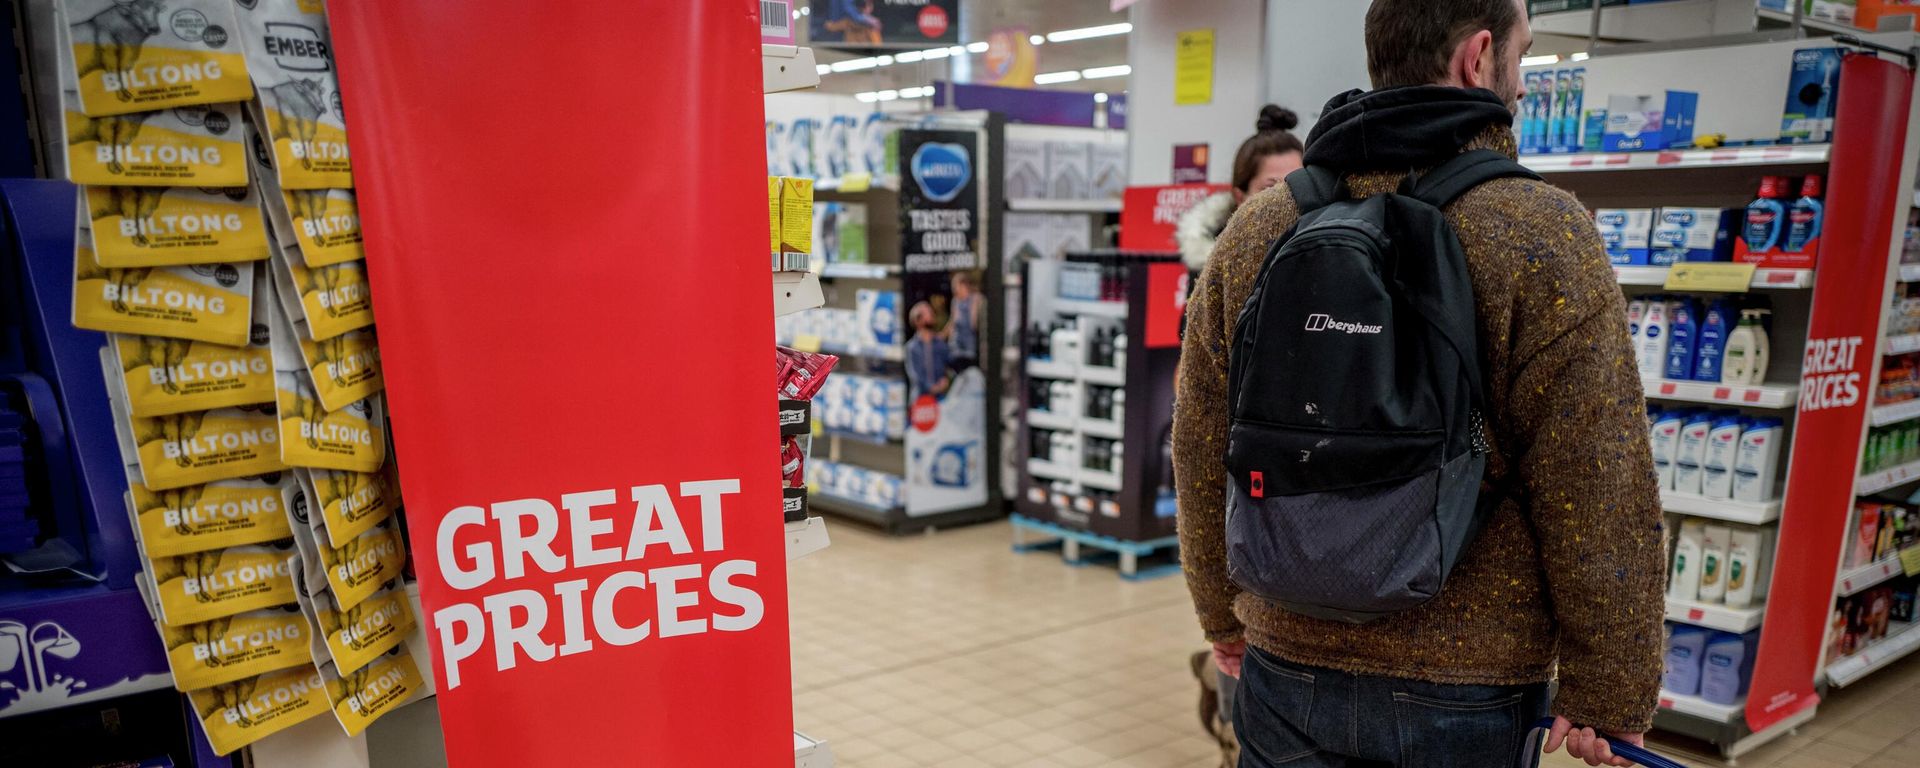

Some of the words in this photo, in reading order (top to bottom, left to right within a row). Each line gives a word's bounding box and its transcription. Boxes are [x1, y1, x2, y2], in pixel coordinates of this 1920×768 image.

[264, 36, 329, 60] EMBER
[101, 60, 222, 92] BILTONG
[96, 144, 221, 164] BILTONG
[119, 213, 242, 236] BILTONG
[103, 284, 225, 314] BILTONG
[1328, 318, 1382, 334] berghaus
[150, 358, 268, 384] BILTONG
[164, 428, 276, 458] BILTONG
[300, 422, 371, 444] BILTONG
[164, 496, 278, 527] BILTONG
[435, 478, 740, 590] GREAT
[338, 540, 395, 582] BILTONG
[183, 560, 290, 595] BILTONG
[340, 601, 400, 646] BILTONG
[433, 560, 765, 690] PRICES
[193, 624, 300, 661] BILTONG
[224, 674, 322, 724] BILTONG
